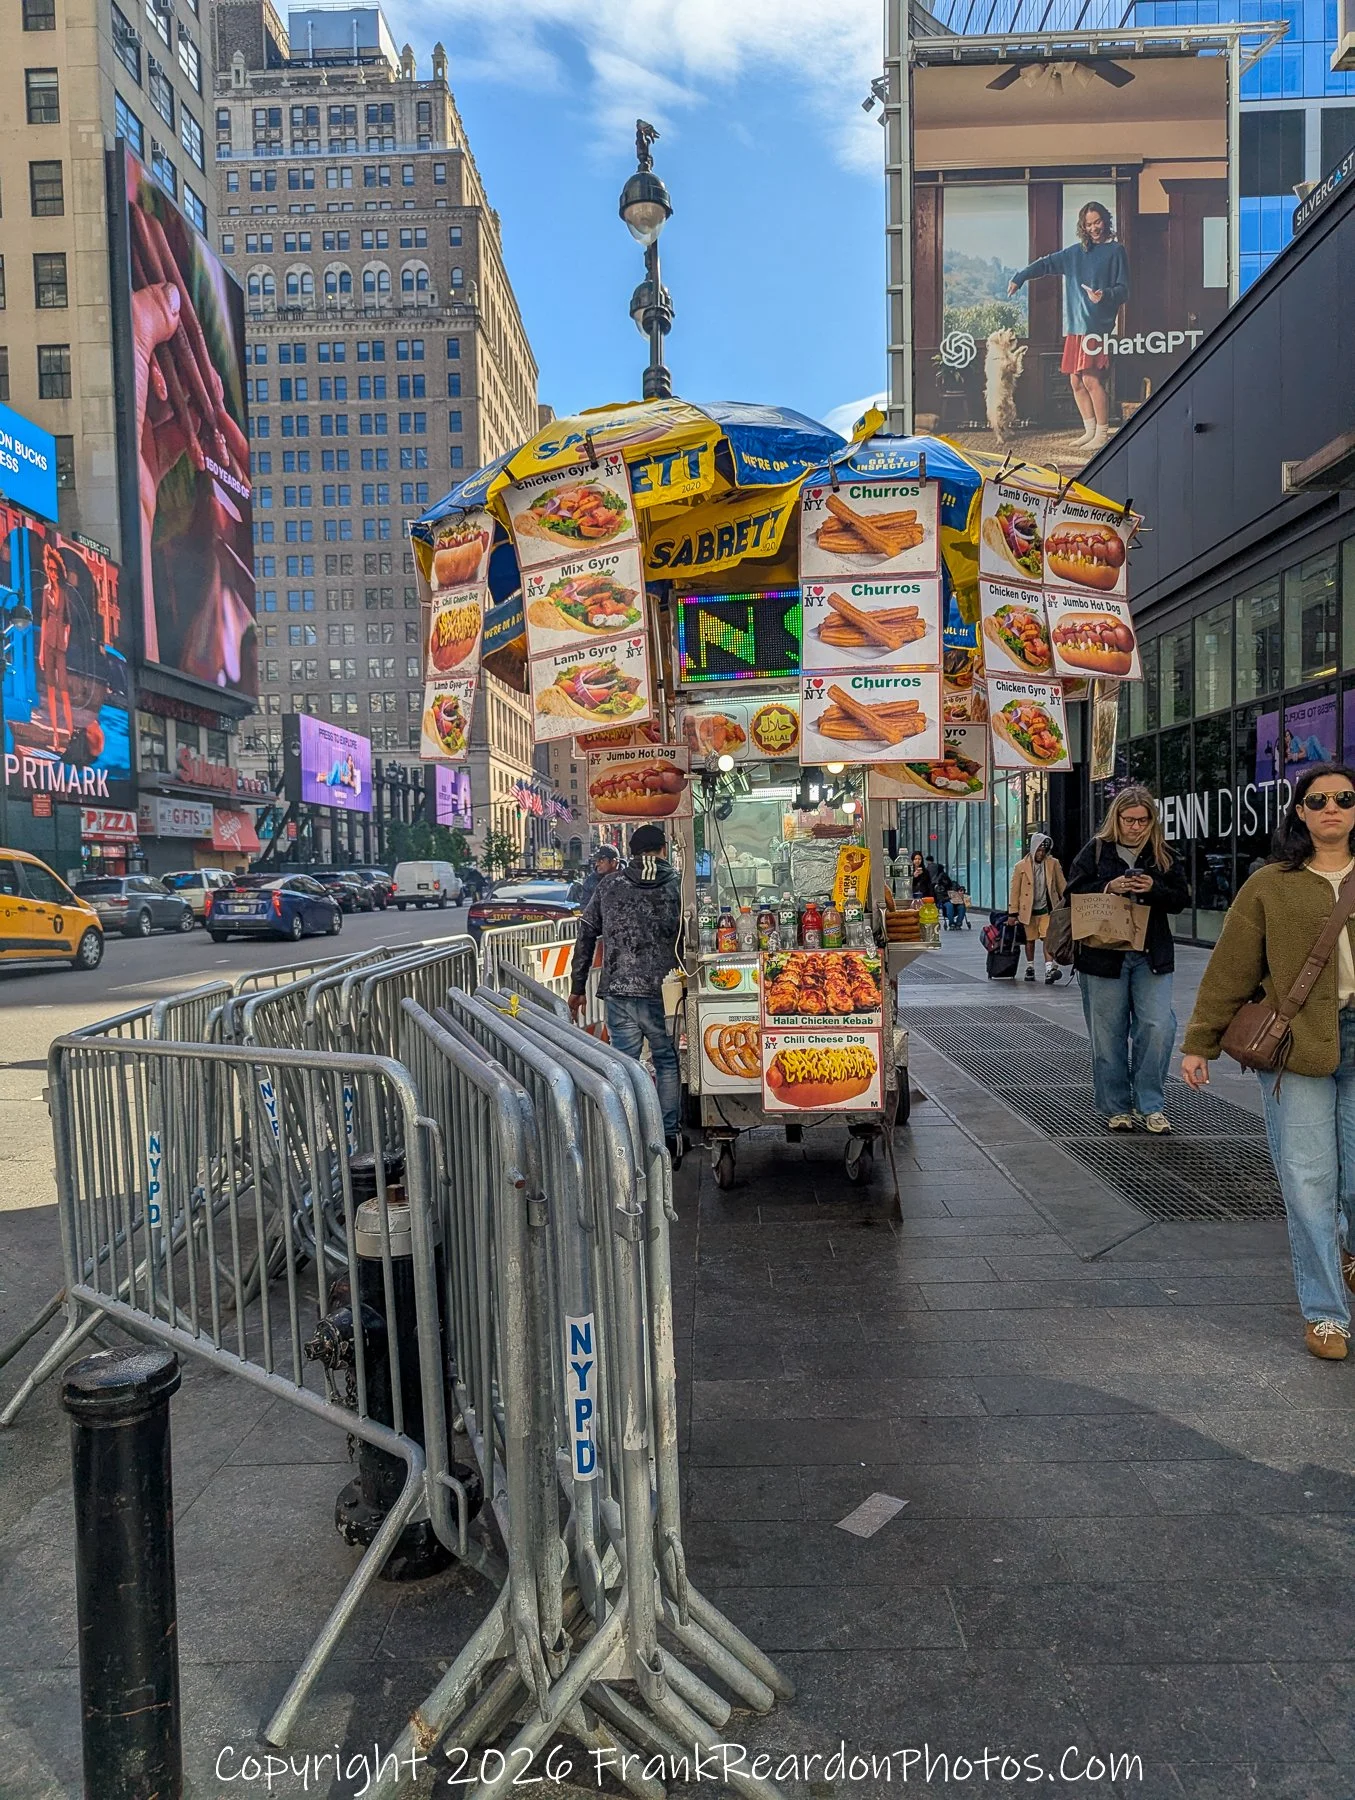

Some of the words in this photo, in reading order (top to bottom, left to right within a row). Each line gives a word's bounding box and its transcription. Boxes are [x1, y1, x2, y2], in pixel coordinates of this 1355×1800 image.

[1296, 151, 1355, 226] SILVERCAST
[1080, 329, 1204, 356] ChatGPT
[14, 439, 48, 471] BUCKS
[604, 457, 610, 467] I
[741, 452, 771, 471] WE'RE
[604, 464, 623, 478] NY
[856, 460, 918, 472] INSPECTED
[218, 466, 241, 494] YEARS
[516, 472, 566, 491] Chicken
[568, 463, 598, 479] Gyr
[681, 481, 701, 494] 2020
[850, 486, 920, 500] Churros
[806, 490, 812, 500] I
[998, 486, 1021, 501] Lamb
[1022, 491, 1040, 507] Gyro
[803, 499, 824, 512] NY
[1062, 504, 1089, 519] Jumbo
[1090, 508, 1106, 522] Hot
[1106, 513, 1123, 528] Dog
[648, 501, 788, 570] SABRETT
[561, 563, 585, 578] Mix
[588, 555, 620, 570] Gyro
[528, 578, 534, 588] I
[527, 584, 546, 598] NY
[806, 586, 811, 597] I
[851, 584, 921, 597] Churros
[989, 584, 1019, 600] Chicken
[1021, 590, 1039, 604] Gyro
[804, 596, 826, 608] NY
[1062, 596, 1089, 610] Jumbo
[1090, 599, 1106, 611] Hot
[1106, 602, 1122, 616] Dog
[627, 640, 632, 649] I
[554, 650, 586, 666] Lamb
[589, 644, 617, 658] Gyro
[626, 646, 644, 659] NY
[434, 681, 448, 690] Lamb
[806, 678, 812, 690] I
[851, 676, 922, 689] Churros
[996, 680, 1026, 694] Chicken
[1028, 684, 1047, 697] Gyro
[804, 688, 826, 700] NY
[1050, 696, 1062, 706] NY
[760, 716, 790, 733] حلال
[763, 734, 790, 743] HALAL
[945, 728, 967, 739] yro
[606, 750, 636, 762] Jumbo
[638, 749, 655, 759] Hot
[657, 748, 676, 760] Dog
[4, 753, 110, 798] PRIMARK
[1218, 776, 1299, 838] DISTR
[173, 808, 200, 826] GIFTS
[1076, 904, 1100, 912] QUICK
[773, 1016, 798, 1025] Halal
[800, 1016, 840, 1025] Chicken
[842, 1016, 874, 1025] Kebab
[784, 1036, 805, 1044] Chili
[808, 1036, 844, 1044] Cheese
[846, 1035, 865, 1044] Dog
[260, 1082, 280, 1148] NYP
[148, 1135, 161, 1224] NYPD
[570, 1322, 596, 1474] NYPD
